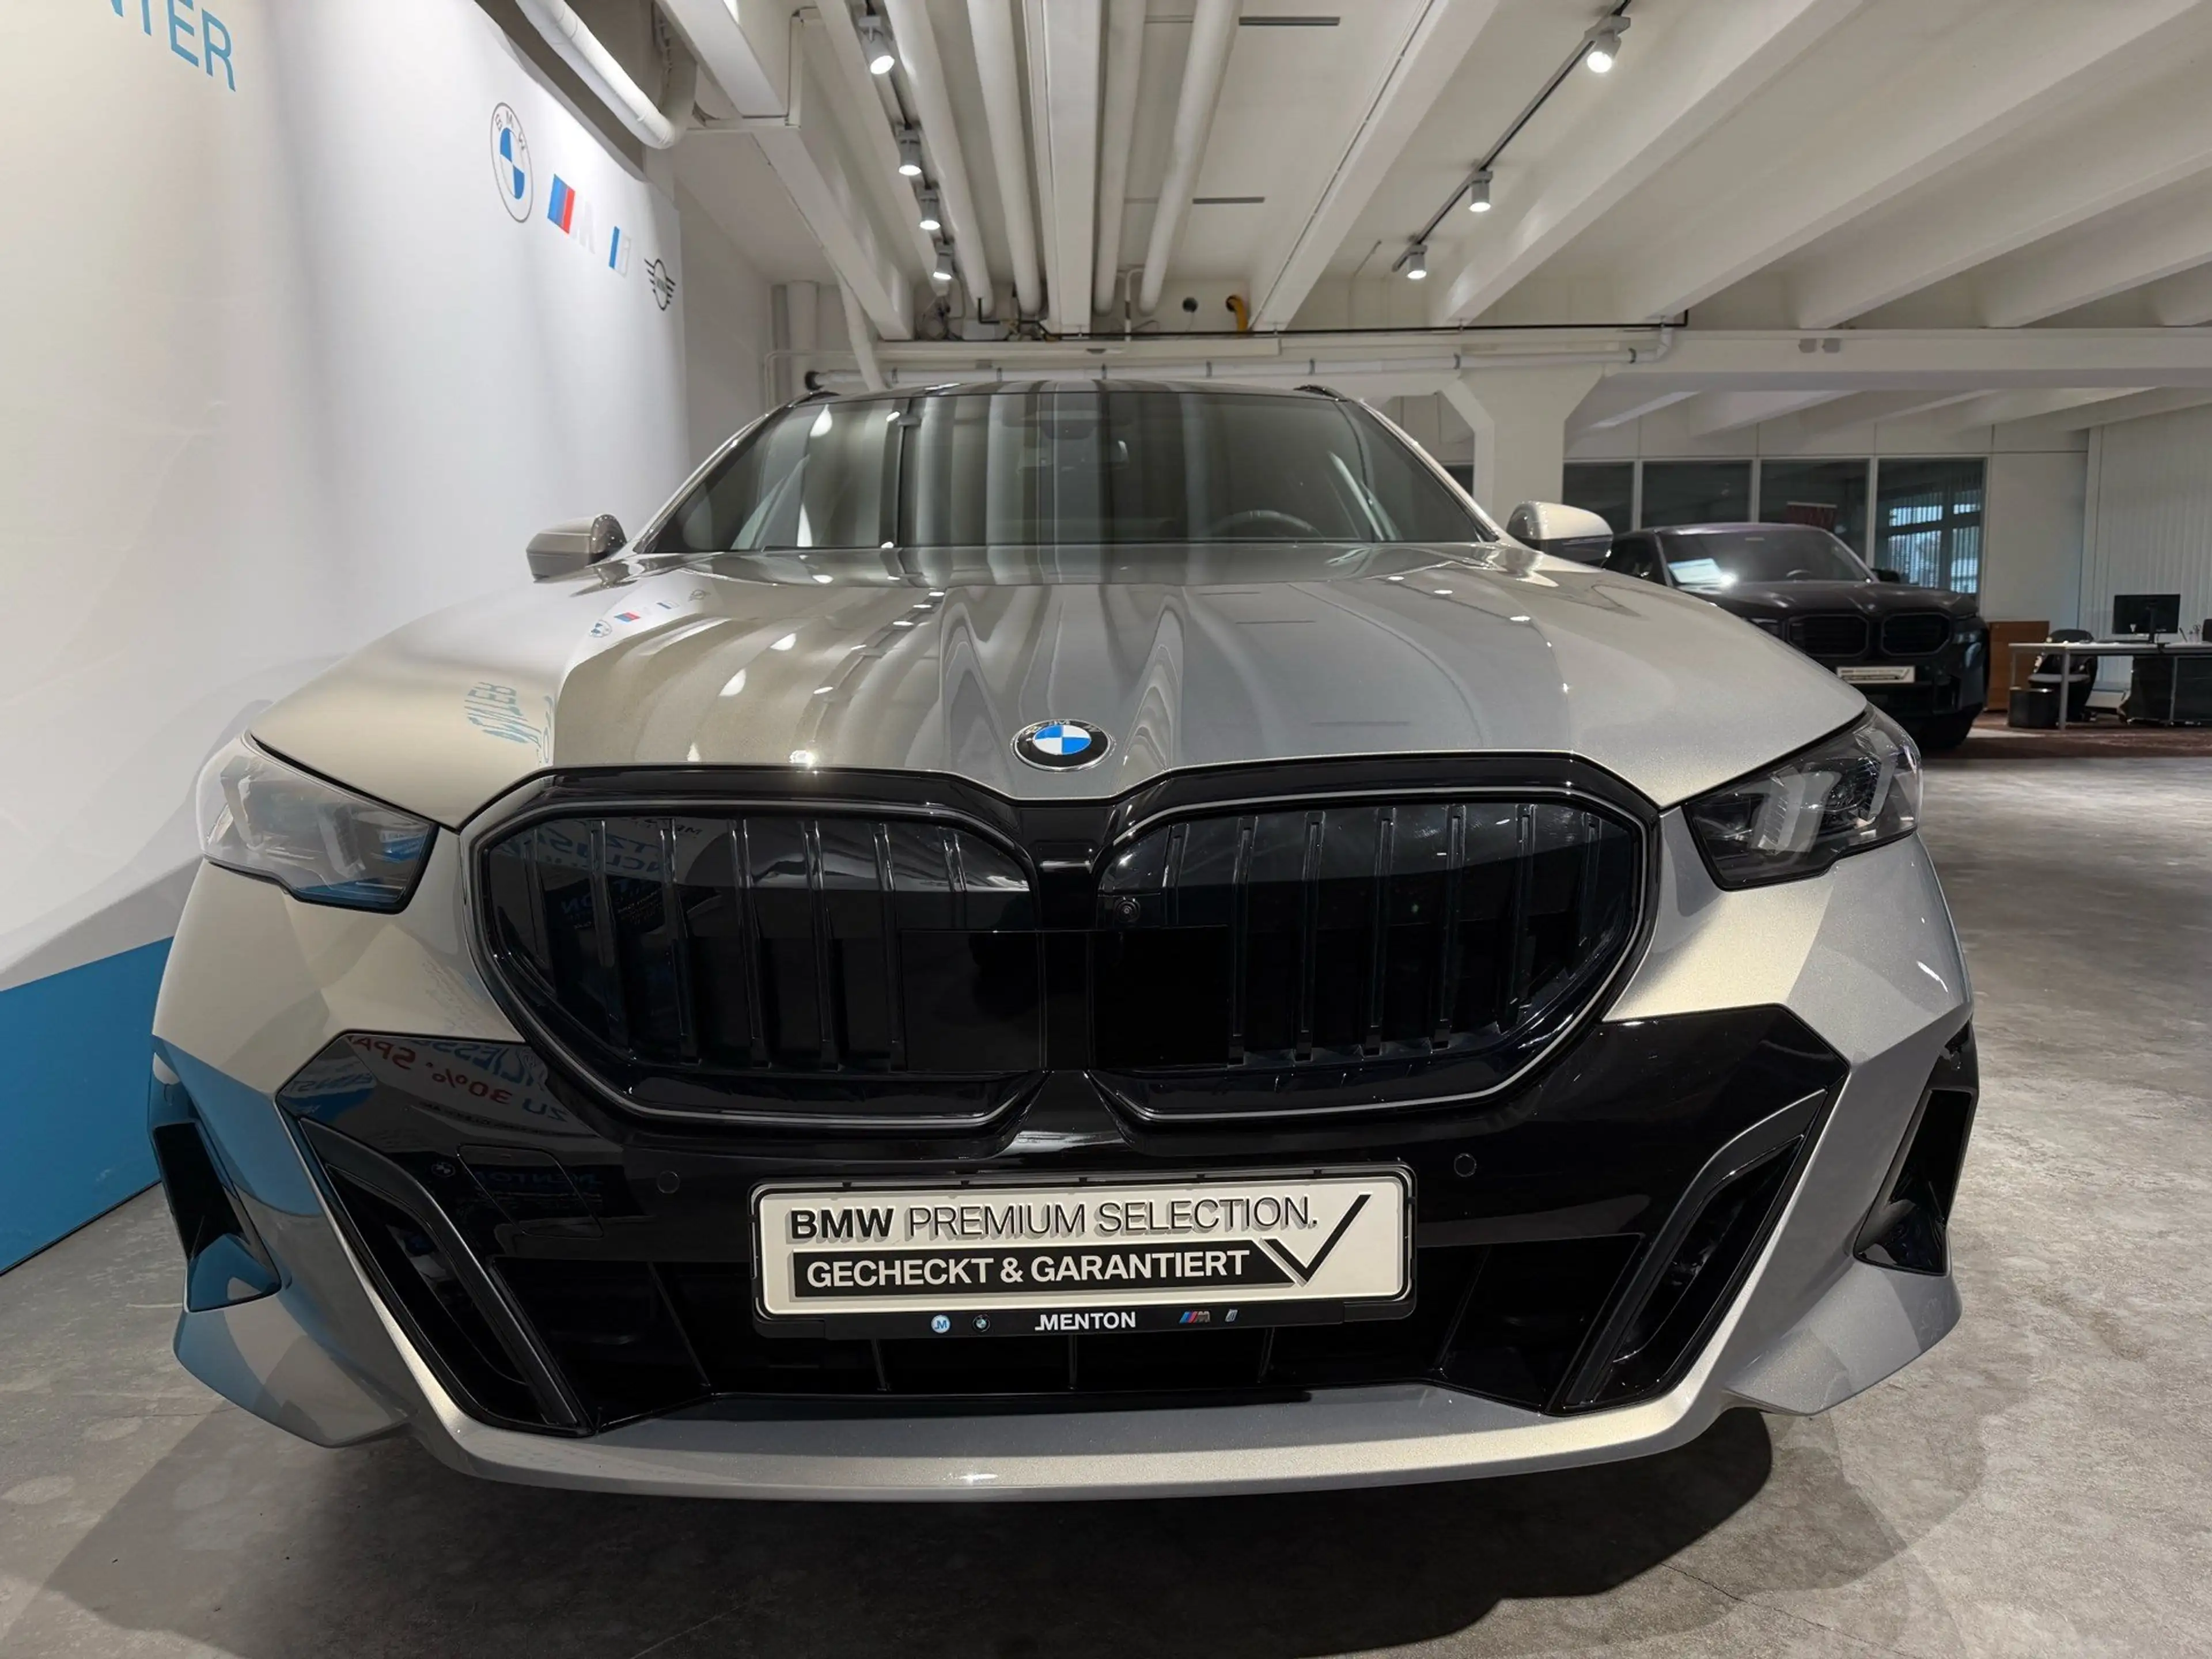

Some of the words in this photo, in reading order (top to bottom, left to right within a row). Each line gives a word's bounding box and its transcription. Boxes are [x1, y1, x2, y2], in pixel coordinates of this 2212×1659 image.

[109, 0, 236, 92] ER
[791, 1207, 895, 1240] BMW
[908, 1203, 1088, 1238] PREMIUM
[1098, 1196, 1319, 1234] SELECTION.
[806, 1257, 994, 1289] GECHECKT
[1000, 1259, 1024, 1284] &
[1031, 1249, 1250, 1282] GARANTIERT
[1035, 1311, 1137, 1337] MENTON
